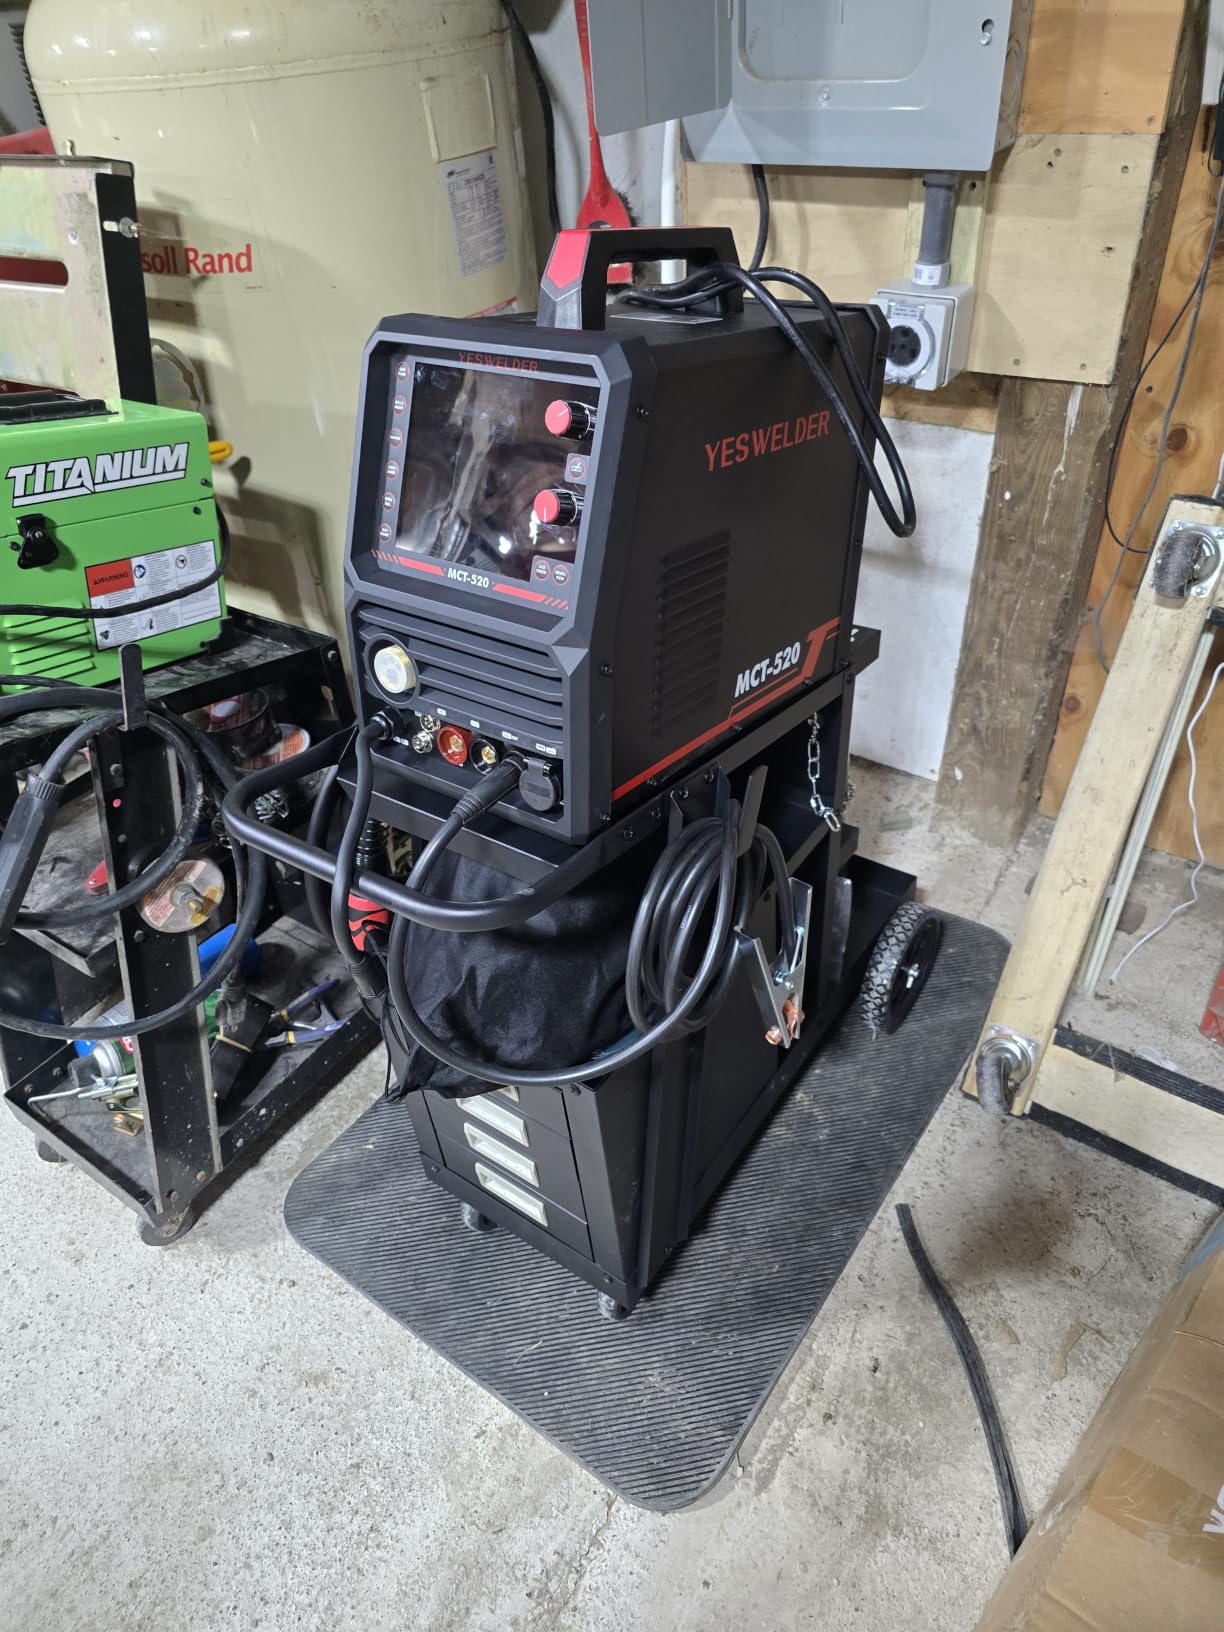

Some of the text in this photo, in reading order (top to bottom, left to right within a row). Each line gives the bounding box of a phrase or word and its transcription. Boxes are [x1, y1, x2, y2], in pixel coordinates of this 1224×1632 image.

[184, 243, 252, 274] Rand
[458, 351, 539, 373] YESWELDER
[704, 410, 830, 472] YESWELDER
[6, 442, 189, 498] TITANIUM
[99, 572, 129, 584] WARNING
[447, 567, 489, 588] MCT-520
[734, 641, 801, 699] MCT-520
